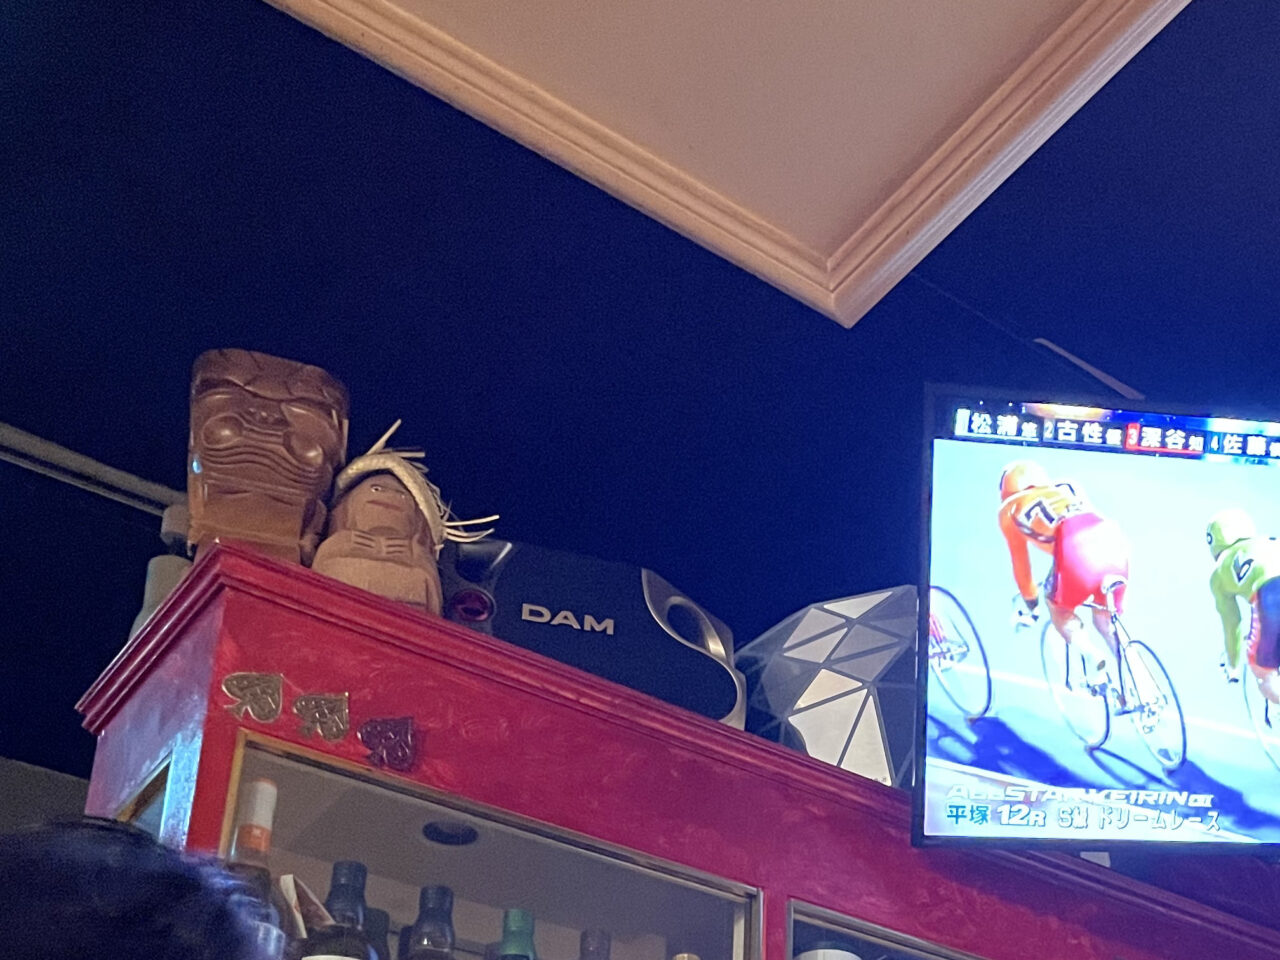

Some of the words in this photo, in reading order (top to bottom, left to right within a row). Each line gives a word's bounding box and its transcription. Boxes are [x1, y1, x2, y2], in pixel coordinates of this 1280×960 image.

[521, 603, 615, 636] DAM
[946, 804, 990, 825] 平塚
[996, 804, 1046, 827] 12R
[1099, 806, 1221, 832] ドリームレース
